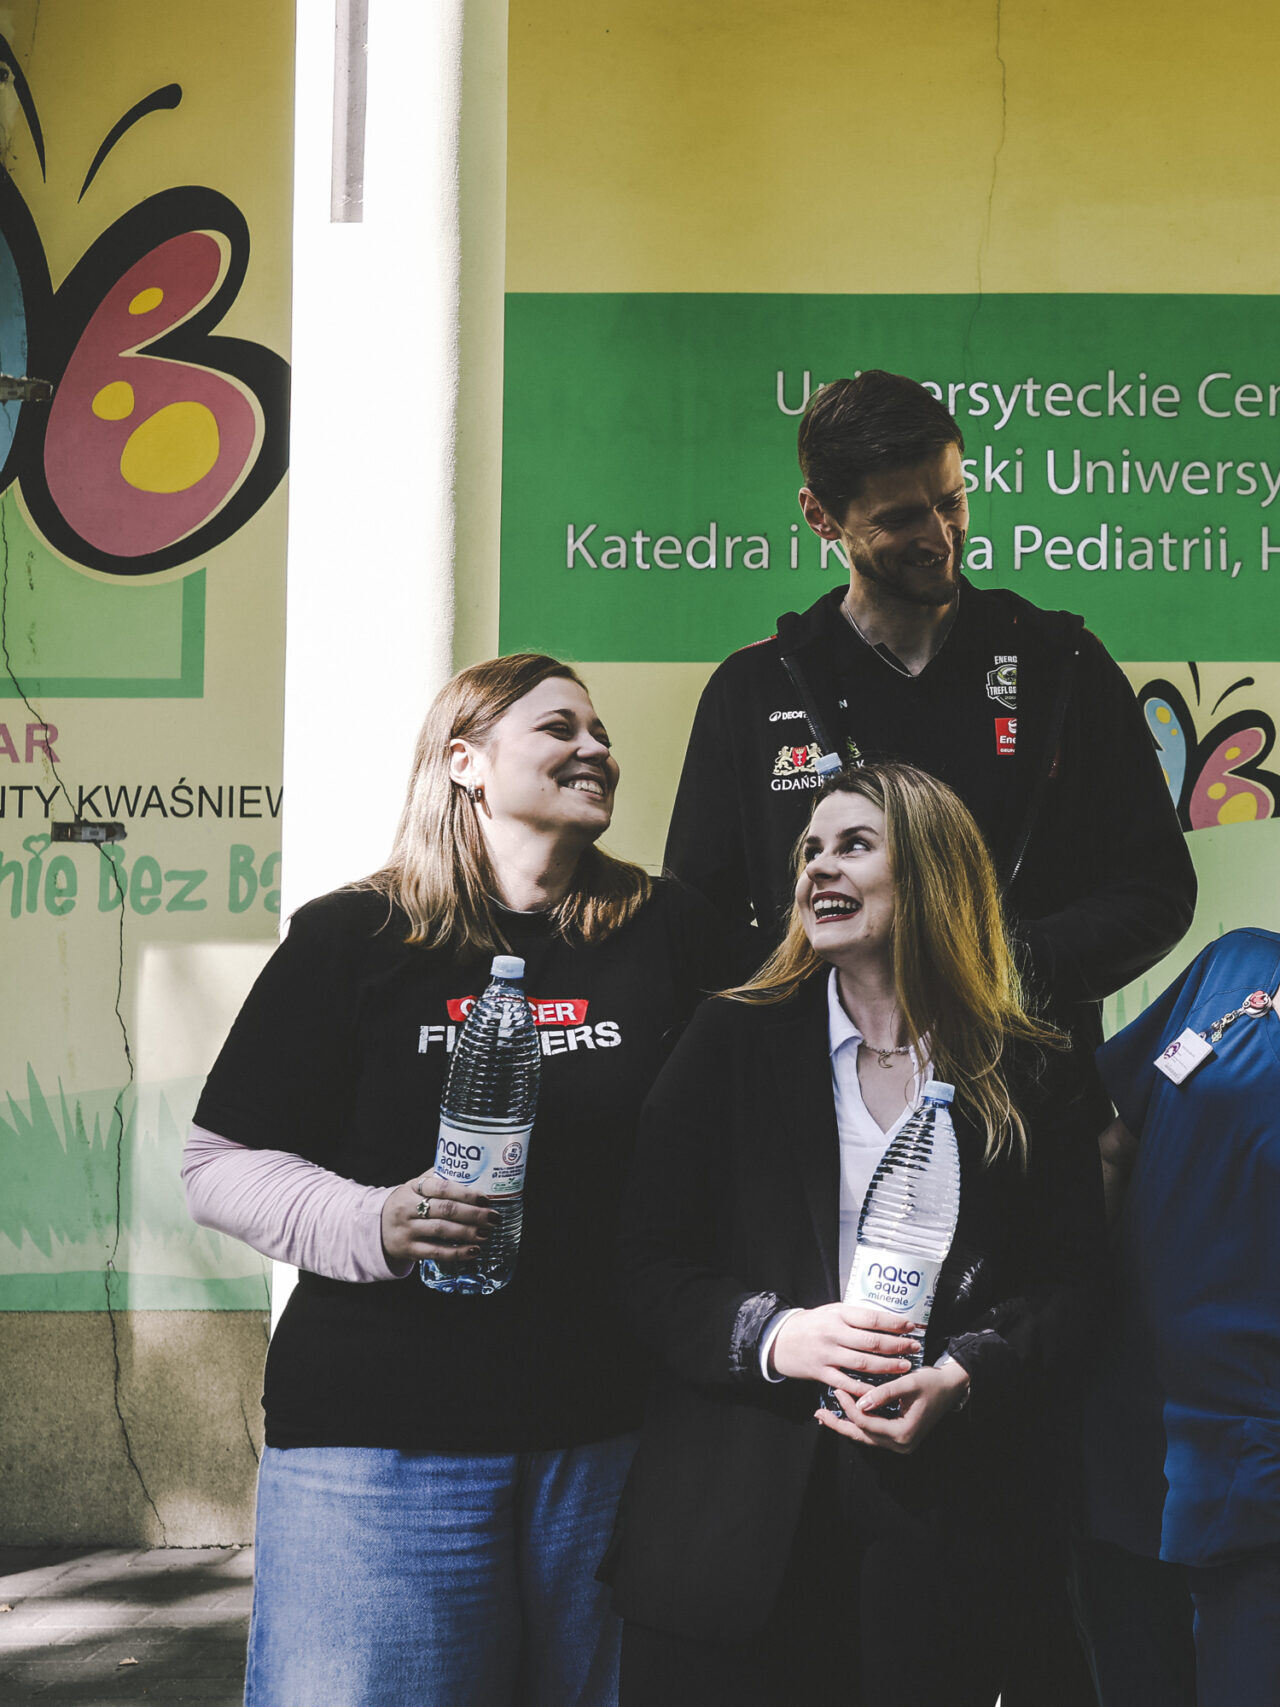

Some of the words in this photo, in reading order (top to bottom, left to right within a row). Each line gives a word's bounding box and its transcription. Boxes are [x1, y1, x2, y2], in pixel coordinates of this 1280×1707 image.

[566, 522, 769, 570] Katedra
[790, 523, 799, 569] i
[1013, 524, 1242, 578] Pediatrii,
[0, 785, 60, 818] TY
[98, 843, 208, 915] Bez
[418, 1021, 622, 1056] FIERS
[437, 1137, 482, 1161] nata
[440, 1155, 469, 1169] aqua
[867, 1262, 921, 1287] nata
[867, 1291, 909, 1306] minerale
[874, 1281, 908, 1296] aqua
